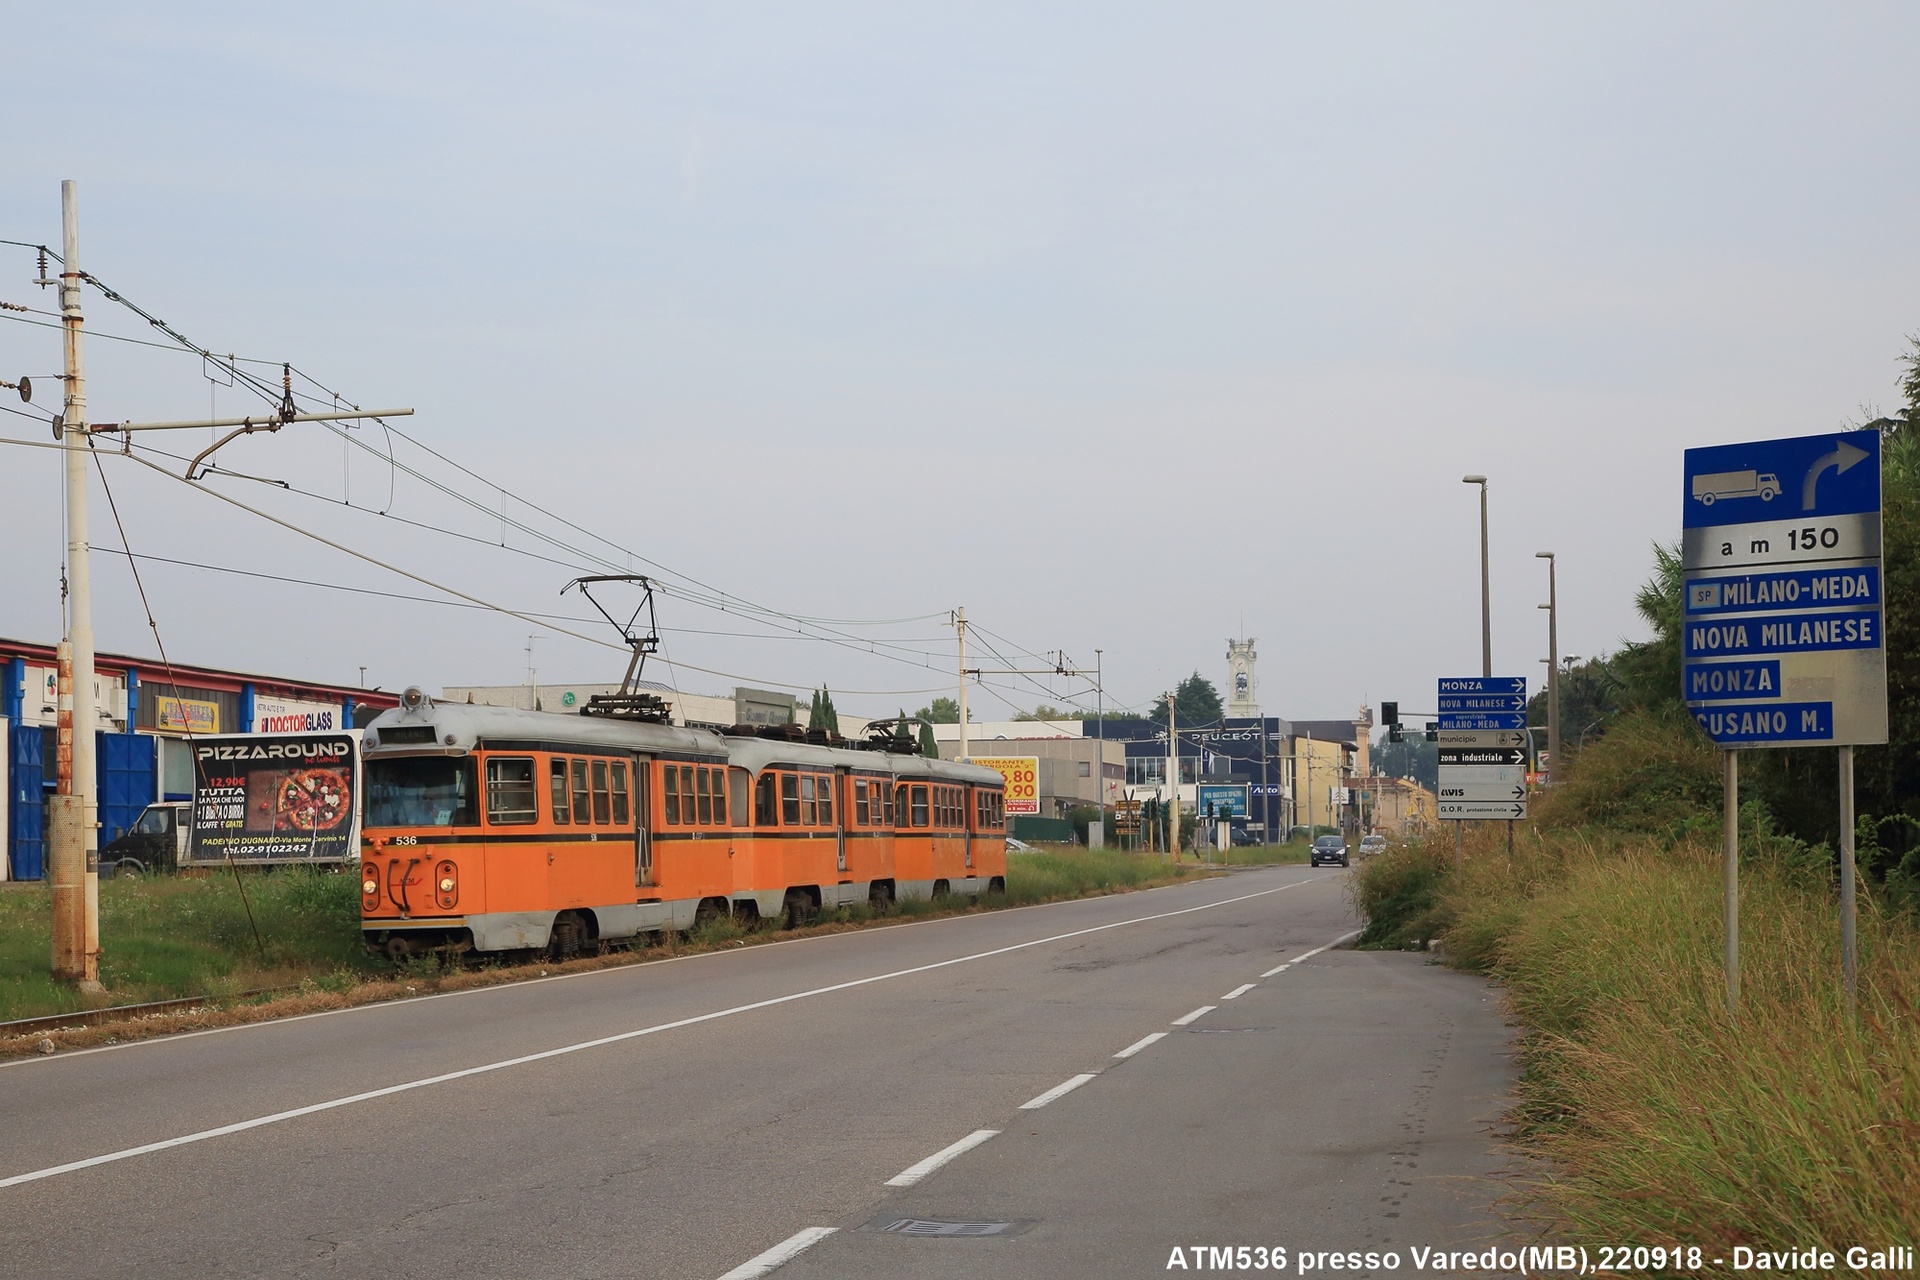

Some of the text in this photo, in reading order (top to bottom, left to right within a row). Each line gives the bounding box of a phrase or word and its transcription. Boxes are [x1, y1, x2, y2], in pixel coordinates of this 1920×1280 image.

[1721, 527, 1840, 556] a m 150
[1697, 575, 1870, 606] SP MILANO-MEDA
[1692, 618, 1872, 650] NOVA MILANESE
[1441, 681, 1483, 690] MONZA
[1692, 667, 1773, 693] MONZA
[1440, 699, 1506, 708] NOVA MILANESE
[269, 711, 333, 733] DOCTORGLASS
[1801, 710, 1825, 732] M.
[1440, 734, 1477, 744] municipio
[198, 742, 350, 761] PIZZAROUND
[1440, 752, 1503, 762] zona industriale
[210, 777, 246, 788] 12,90€
[199, 787, 245, 796] TUTTA
[1441, 788, 1464, 797] AVIS
[1440, 805, 1465, 813] G.O.R.
[225, 820, 244, 828] GRATIS
[395, 835, 418, 846] 536
